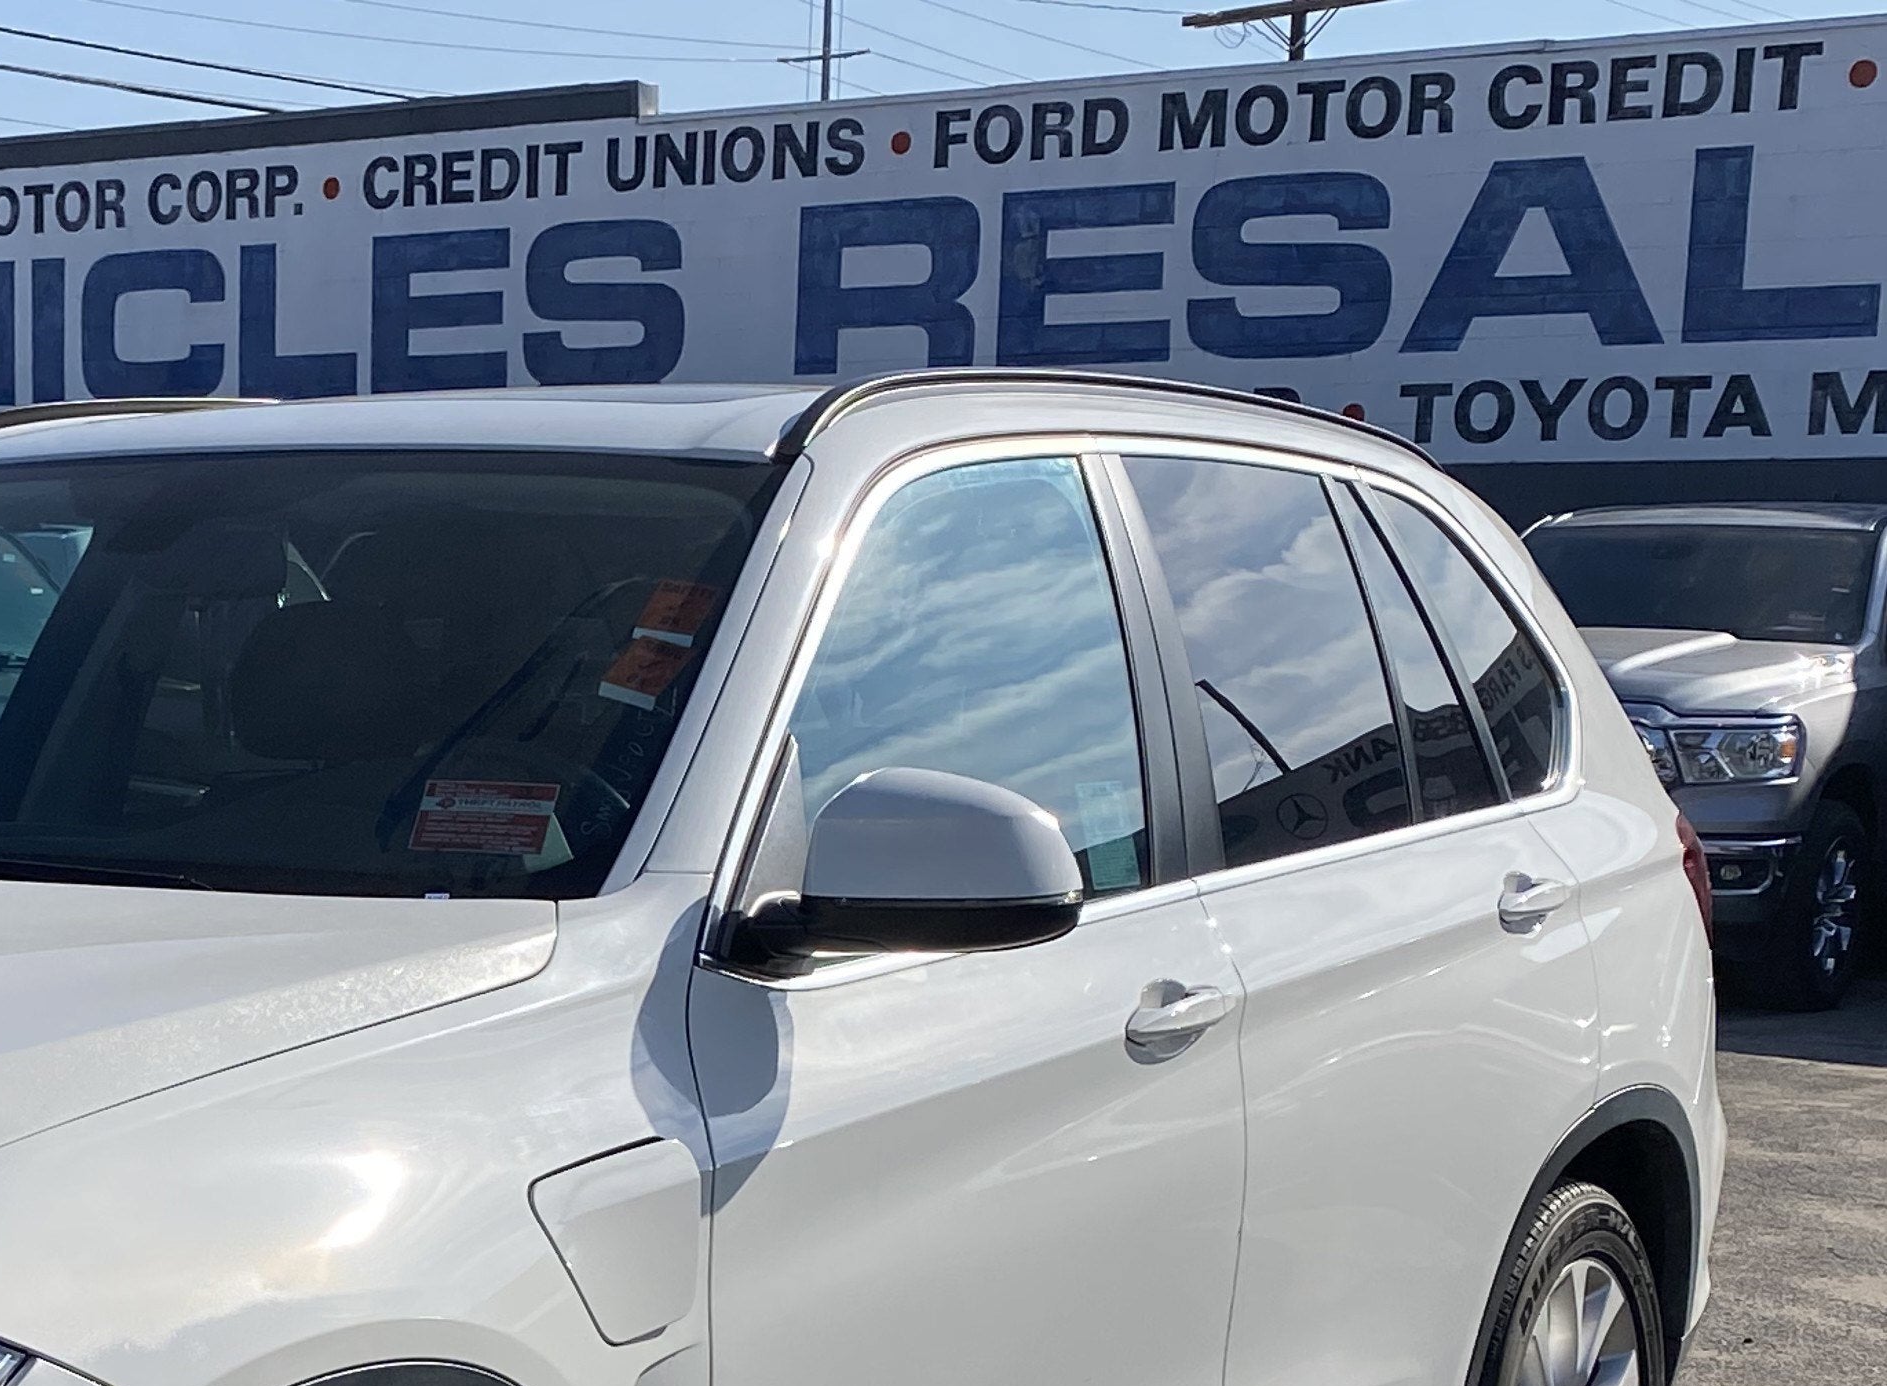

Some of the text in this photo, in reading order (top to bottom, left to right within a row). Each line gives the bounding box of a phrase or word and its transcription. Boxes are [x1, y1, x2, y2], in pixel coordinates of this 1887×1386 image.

[932, 41, 1825, 170] FORD MOTOR CREDIT
[149, 164, 305, 226] CORP.
[362, 118, 867, 211] CREDIT UNIONS
[1398, 374, 1773, 446] TOYOTA
